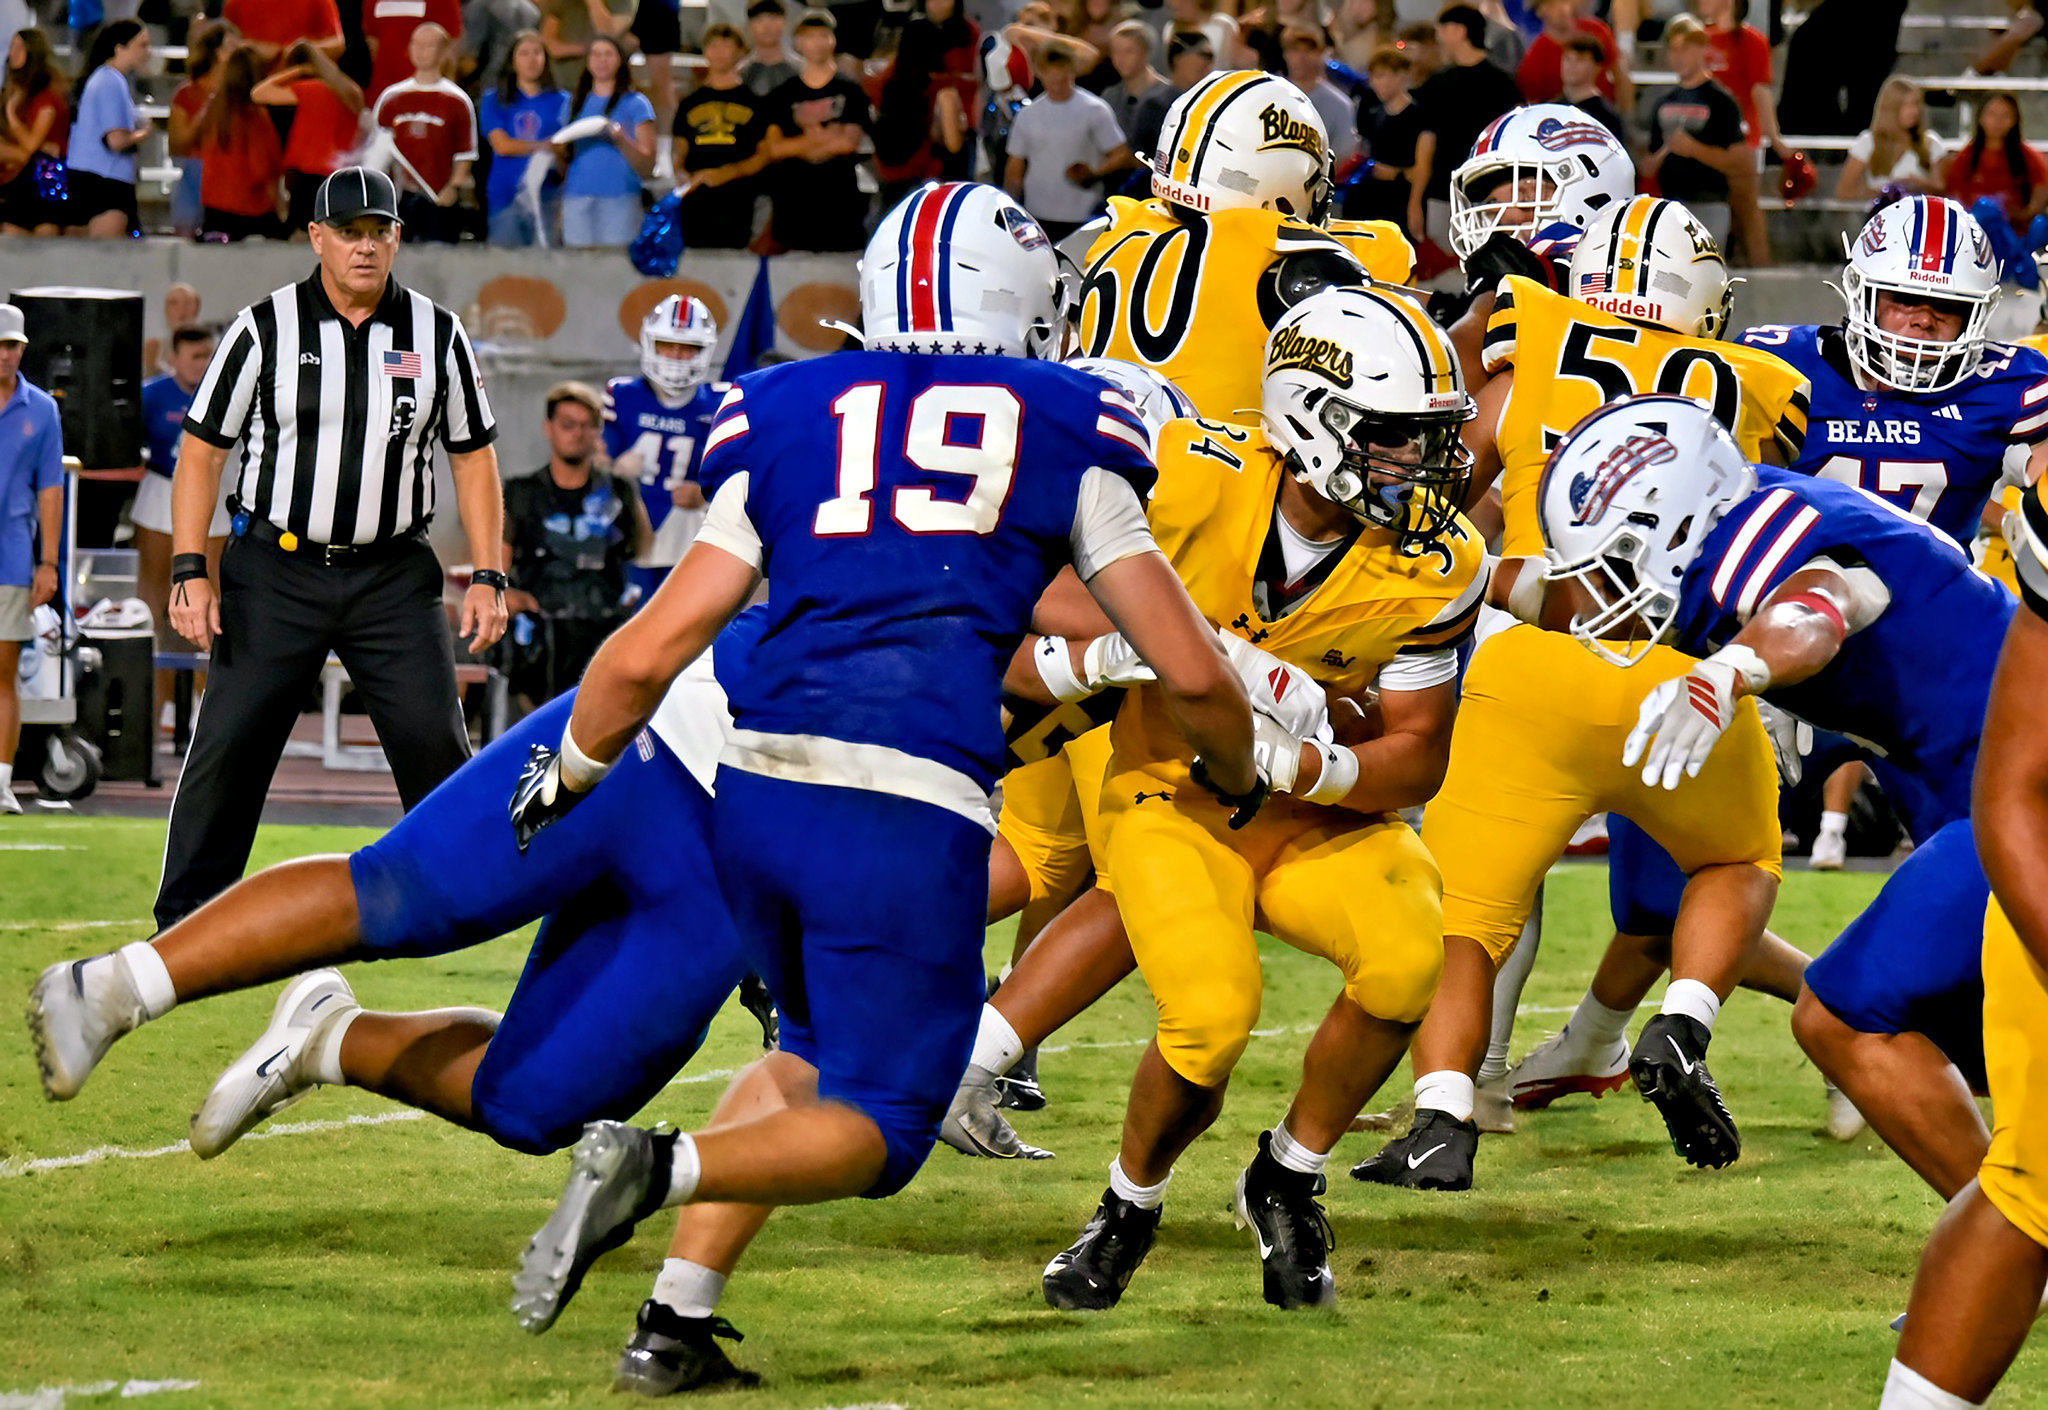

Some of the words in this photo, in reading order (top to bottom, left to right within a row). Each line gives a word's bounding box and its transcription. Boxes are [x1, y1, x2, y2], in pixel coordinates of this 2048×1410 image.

[1258, 102, 1324, 157] Blaz
[1079, 212, 1211, 366] 60
[1909, 271, 1950, 286] Riddell
[1585, 297, 1662, 321] Riddell
[1267, 324, 1354, 379] Blazers
[810, 378, 1026, 538] 19
[1826, 420, 1921, 445] BEARS
